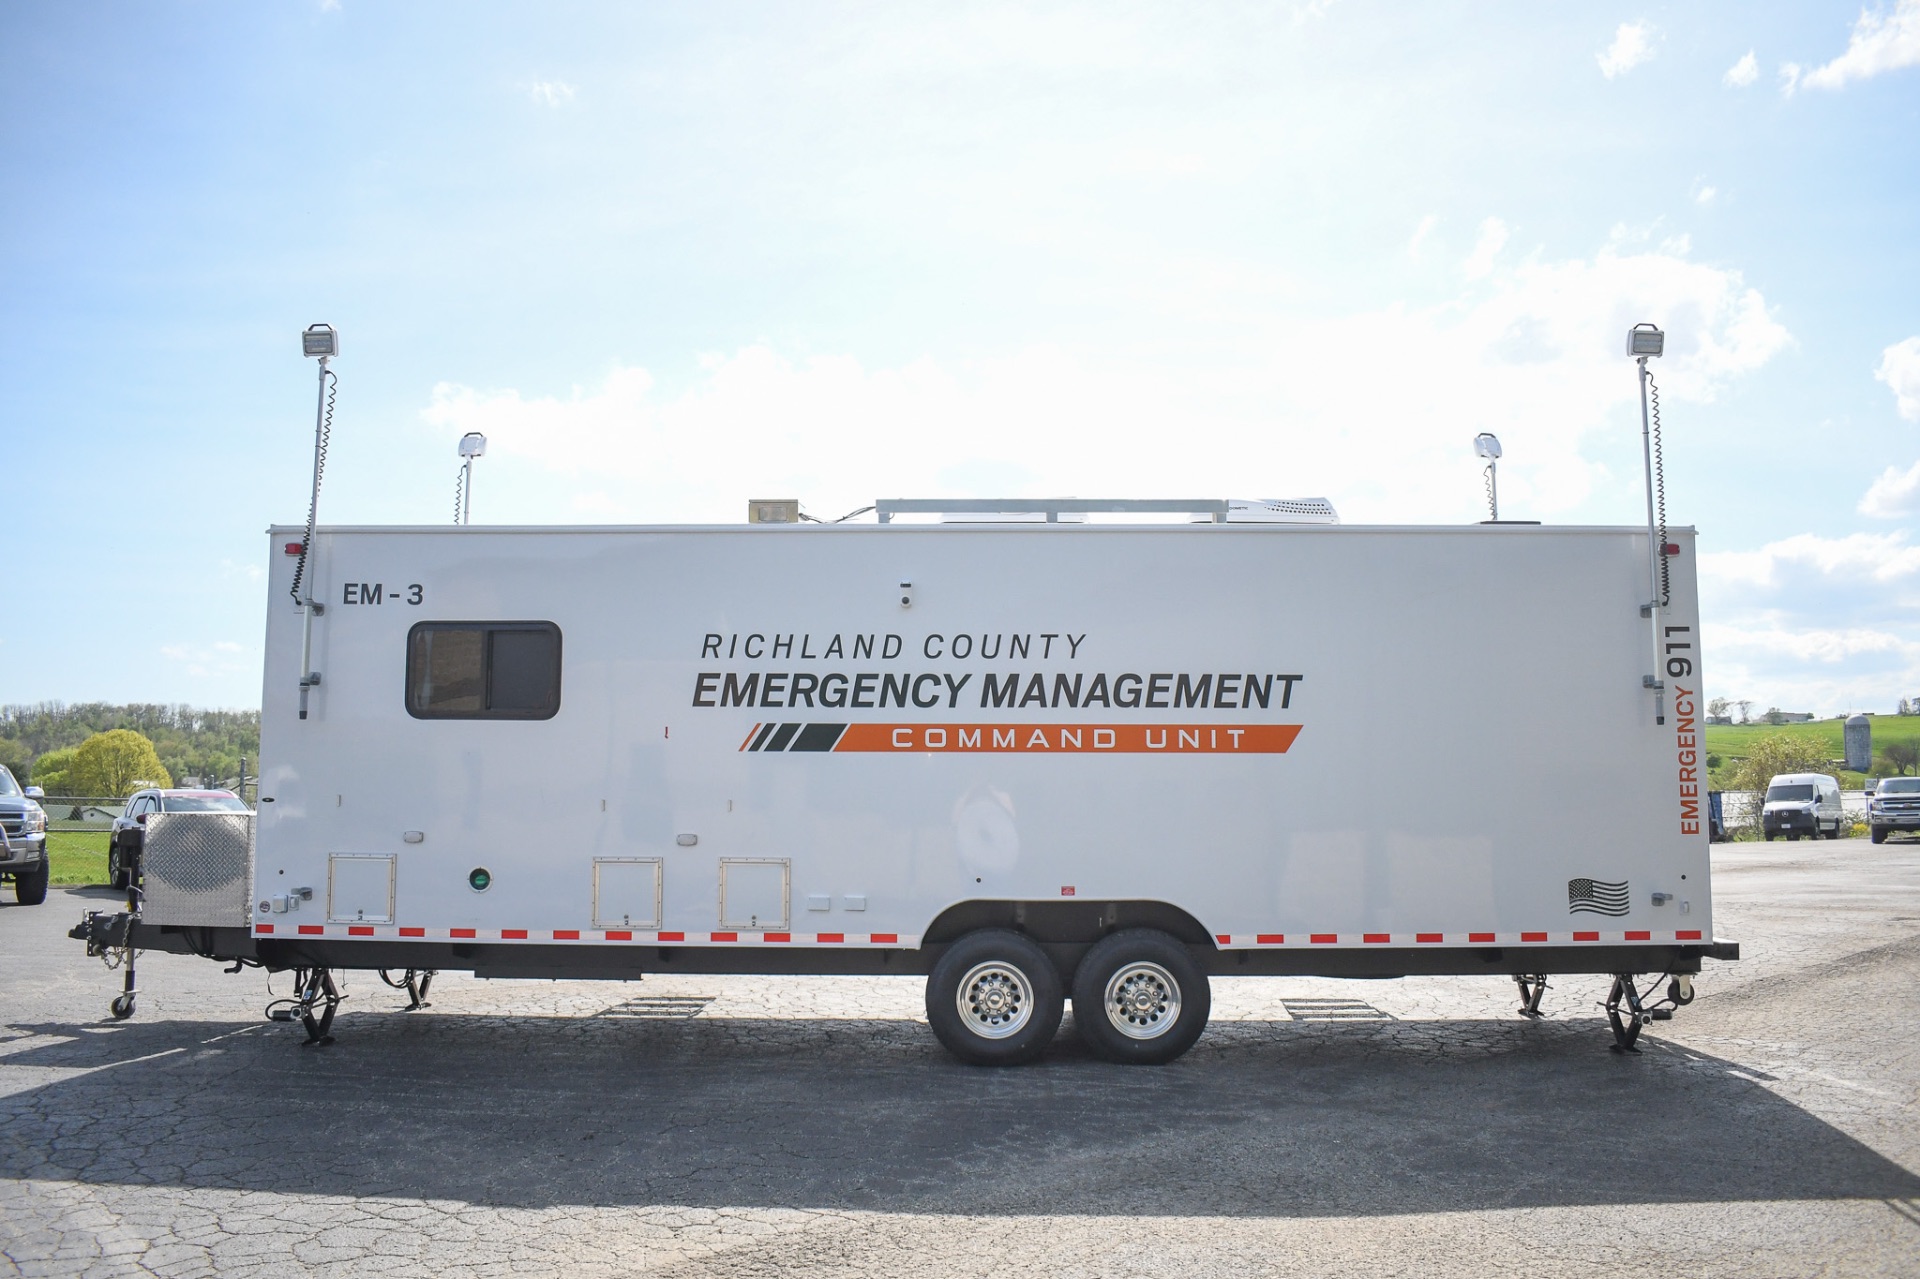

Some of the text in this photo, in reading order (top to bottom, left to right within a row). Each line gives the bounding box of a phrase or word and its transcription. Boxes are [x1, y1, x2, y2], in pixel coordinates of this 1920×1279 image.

[701, 633, 1087, 660] RICHLAND COUNTY
[691, 672, 1304, 710] EMERGENCY MANAGEMENT
[892, 728, 1246, 749] COMMAND UNIT
[1664, 625, 1700, 836] EMERGENCY 911
